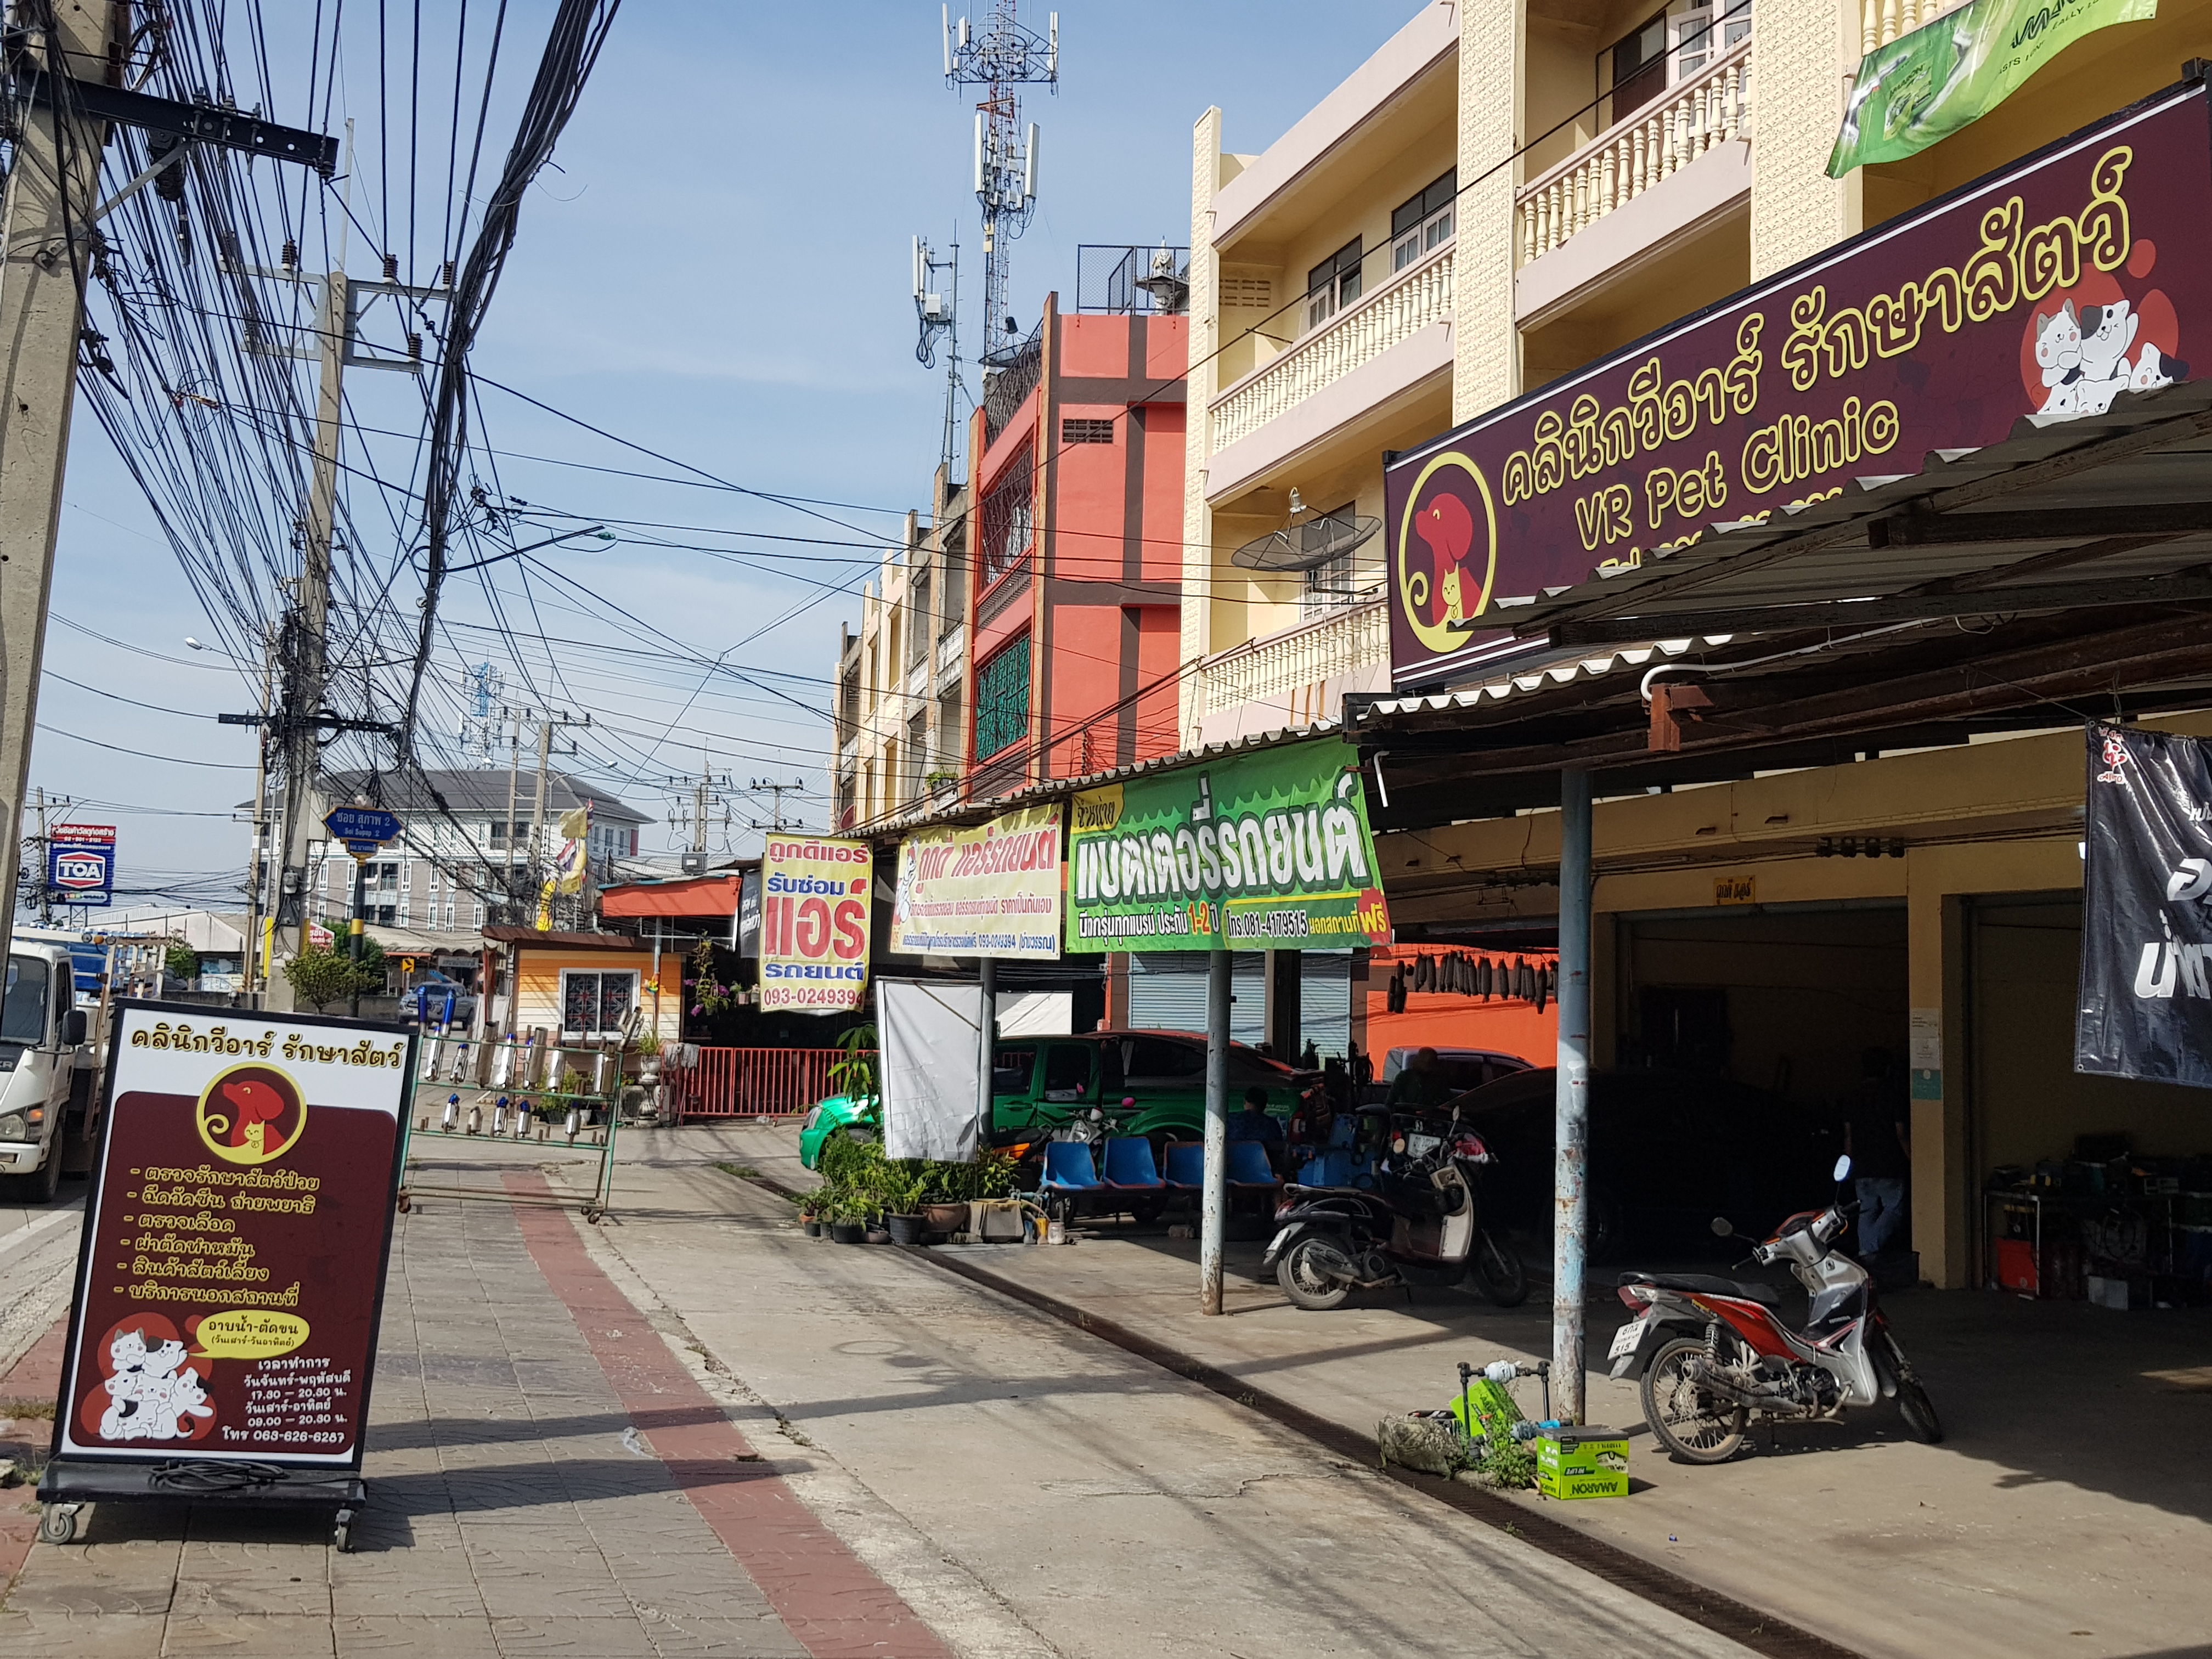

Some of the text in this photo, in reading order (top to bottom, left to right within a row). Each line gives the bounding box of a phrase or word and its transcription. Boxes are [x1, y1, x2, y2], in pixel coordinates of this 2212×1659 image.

[1503, 146, 2133, 506] คลินิกวีอาร์ รักษาสัตว์
[1575, 396, 1900, 550] VR Pet Clinic
[336, 812, 390, 829] ซอย สุภาพ 2
[1077, 795, 1115, 828] จำหน่าย
[951, 814, 1058, 877] แอร์รถยนต์
[1076, 772, 1370, 901] แบตเตอรี่รถยนต์
[769, 839, 869, 864] ถูกดีแอร์
[60, 862, 101, 878] TOA
[768, 872, 845, 896] รับซ่อม
[765, 878, 867, 959] แอร์
[1157, 904, 1189, 935] ประกัน
[1188, 901, 1211, 935] 1-2
[1210, 902, 1220, 933] ปี
[1308, 903, 1361, 934] นอกสถานที่
[1360, 901, 1387, 933] ฟรี
[979, 934, 1016, 949] 093-0249394
[765, 962, 864, 981] รถยนต์
[764, 987, 865, 1007] 093-0249394
[132, 1022, 405, 1069] คลินิกวีอาร์ รักษาสัตว์
[145, 1165, 320, 1191] ตรวจรักษาสัตว์ป่วย
[142, 1184, 317, 1215] ฉีดวัคซีน ถ่ายพยาธิ
[138, 1211, 236, 1232] ตรวจเลือด
[135, 1232, 256, 1257] ผ่าตัดทำหมัน
[132, 1255, 269, 1282] สินค้าสัตว์เลี้ยง
[129, 1280, 301, 1307] บริการนอกสถานที่
[208, 1315, 299, 1334] อาบน้ำ-ตัดขน
[211, 1335, 295, 1347] (วันเสาร์-วันอาทิตย์)
[1614, 1342, 1631, 1355] 515
[258, 1356, 331, 1370] เวลาทำการ
[244, 1369, 351, 1387] วันจันทร์-พฤหัสบดี
[334, 1387, 347, 1397] น.
[245, 1397, 332, 1415] วันเสาร์-อาทิตย์
[247, 1416, 281, 1427] 09.00
[335, 1413, 348, 1423] น.
[222, 1426, 345, 1444] โทร 063-626-6287
[1572, 1481, 1618, 1494] AMARON
